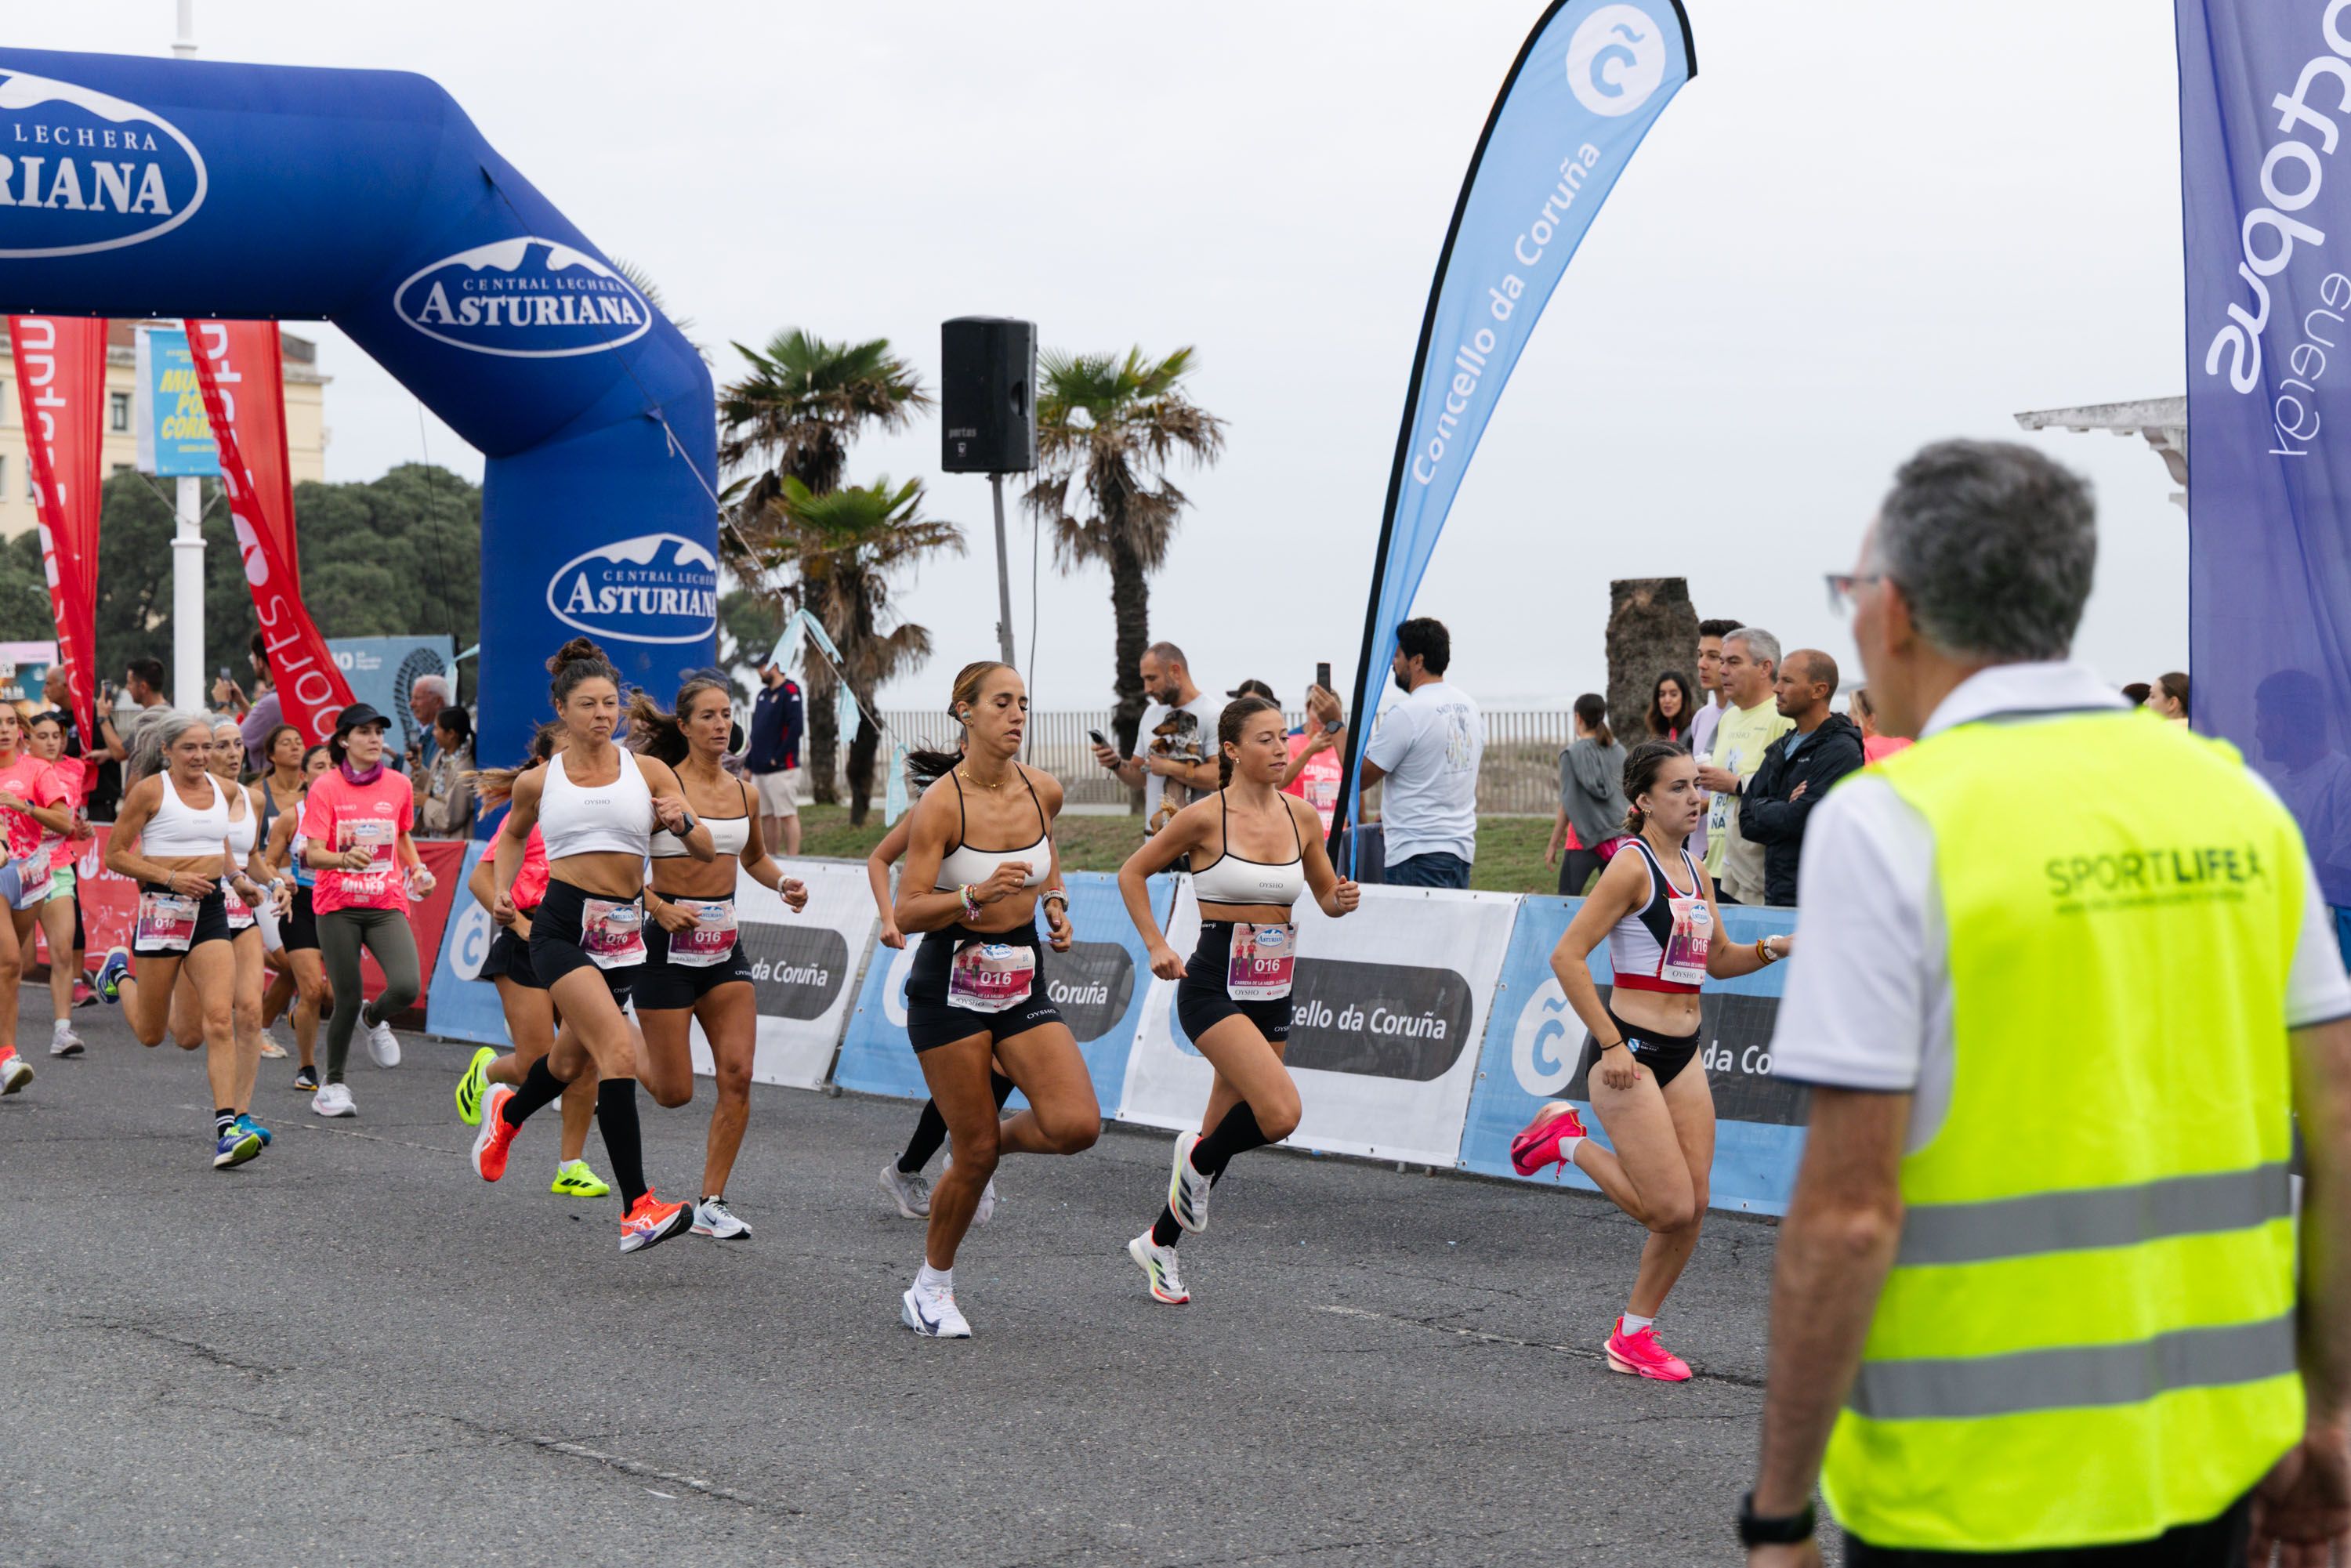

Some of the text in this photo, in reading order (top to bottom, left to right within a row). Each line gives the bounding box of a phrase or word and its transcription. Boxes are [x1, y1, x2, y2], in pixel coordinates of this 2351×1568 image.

[13, 123, 158, 151] LECHERA
[462, 277, 549, 291] CENTRAL
[416, 281, 642, 327] ASTURIANA
[1413, 141, 1601, 487] Concello da Coruña
[602, 570, 674, 583] CENTRAL
[341, 877, 386, 896] MUJER
[154, 918, 177, 929] 016
[694, 932, 722, 943] 016
[1692, 938, 1708, 954] 016
[752, 957, 828, 987] da Coruña
[1255, 958, 1281, 972] 016
[980, 971, 1012, 986] 016
[1672, 970, 1697, 980] OYSHO
[1047, 979, 1108, 1005] Coruña
[958, 997, 985, 1007] OYSHO
[1027, 1009, 1056, 1019] OYSHO
[1338, 1003, 1364, 1031] da
[1370, 1008, 1447, 1040] Coruña
[1702, 1039, 1733, 1072] da
